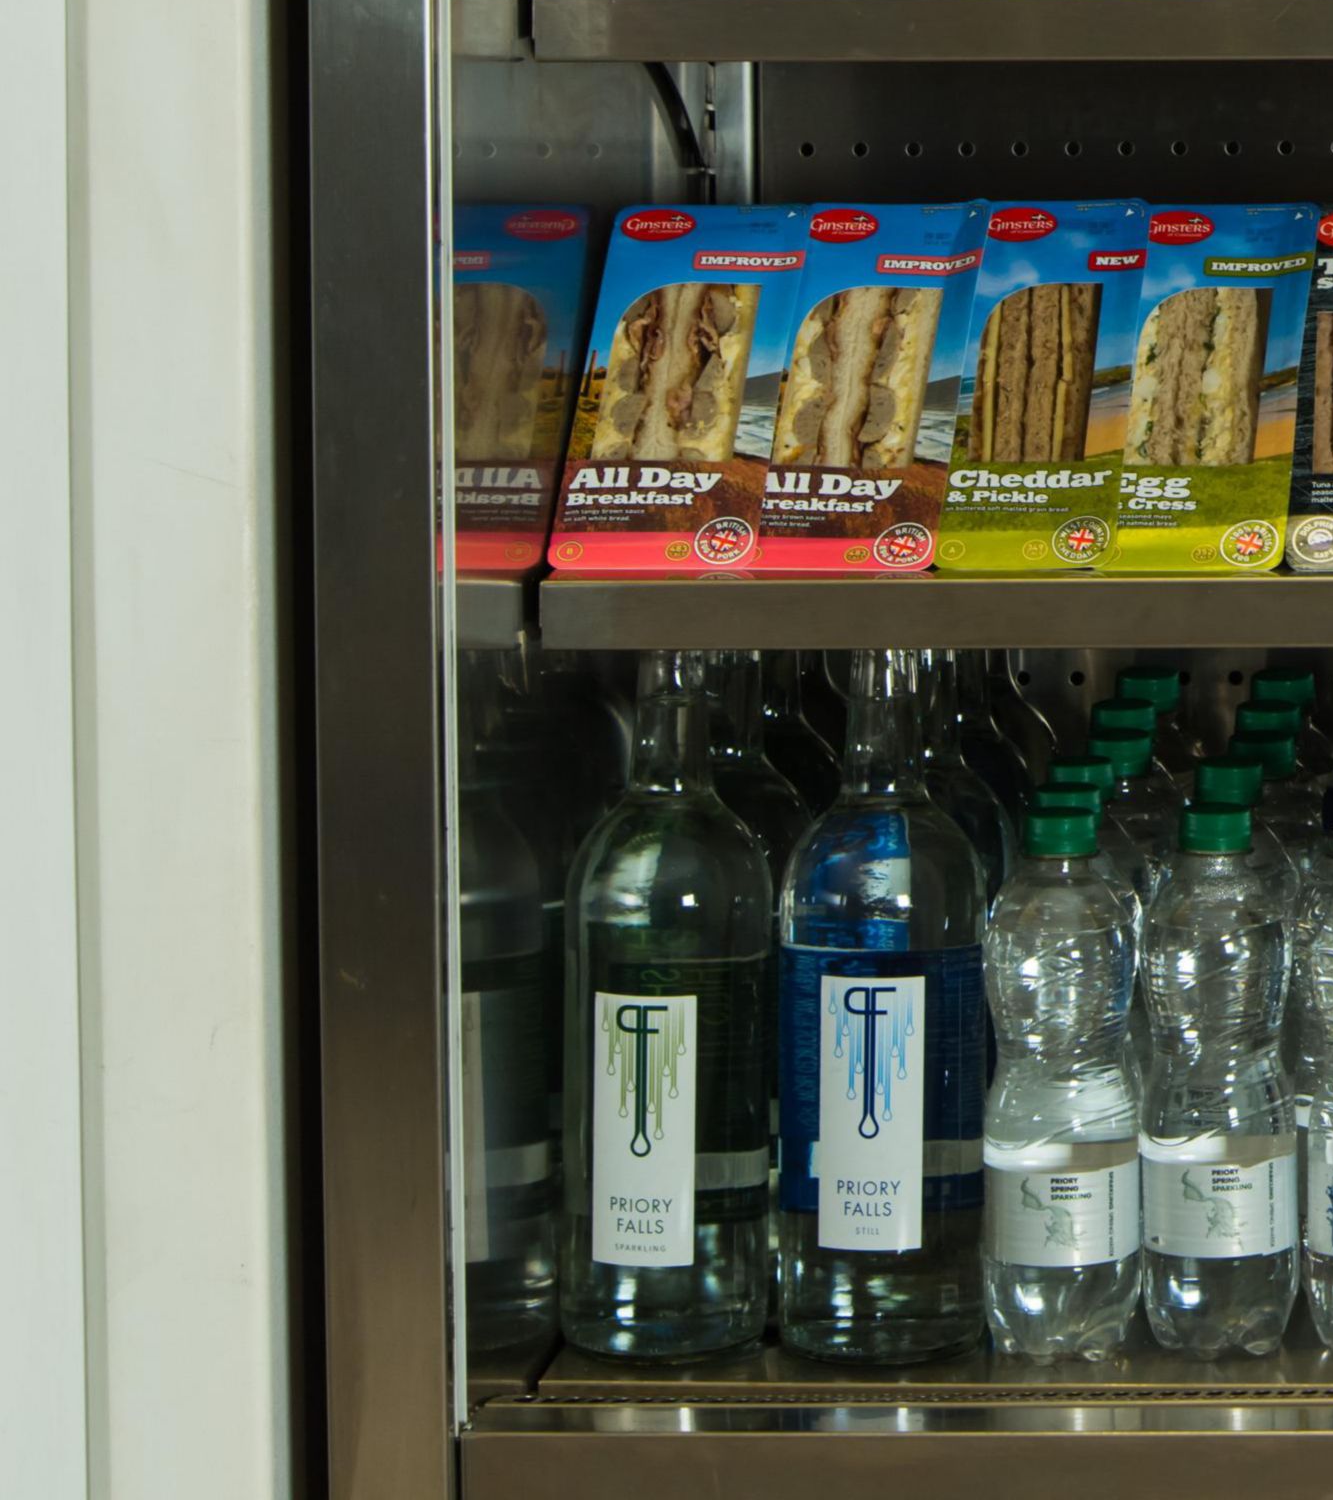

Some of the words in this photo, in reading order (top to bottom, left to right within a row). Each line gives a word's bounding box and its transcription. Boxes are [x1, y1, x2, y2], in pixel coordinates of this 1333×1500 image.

[699, 255, 798, 268] IMPROVED
[883, 255, 977, 272] IMPROVED
[1096, 254, 1139, 267] NEW
[1211, 257, 1307, 273] IMPROVED
[568, 467, 630, 490] All
[637, 467, 723, 493] Day
[949, 468, 1113, 488] Cheddar
[818, 473, 903, 500] Day
[565, 491, 696, 507] Breakfast
[947, 490, 967, 504] &
[971, 489, 1048, 504] Pickle
[1128, 497, 1197, 511] Cress
[715, 521, 748, 537] BRITISH
[1211, 1168, 1240, 1177] PRIORY
[836, 1180, 902, 1197] PRIORY
[1050, 1177, 1079, 1185] PRIORY
[1050, 1185, 1080, 1193] SPRING
[609, 1196, 673, 1214] PRIORY
[843, 1201, 894, 1218] FALLS
[616, 1218, 665, 1235] FALLS
[854, 1226, 881, 1236] STILL
[614, 1242, 668, 1254] SPARKLING
